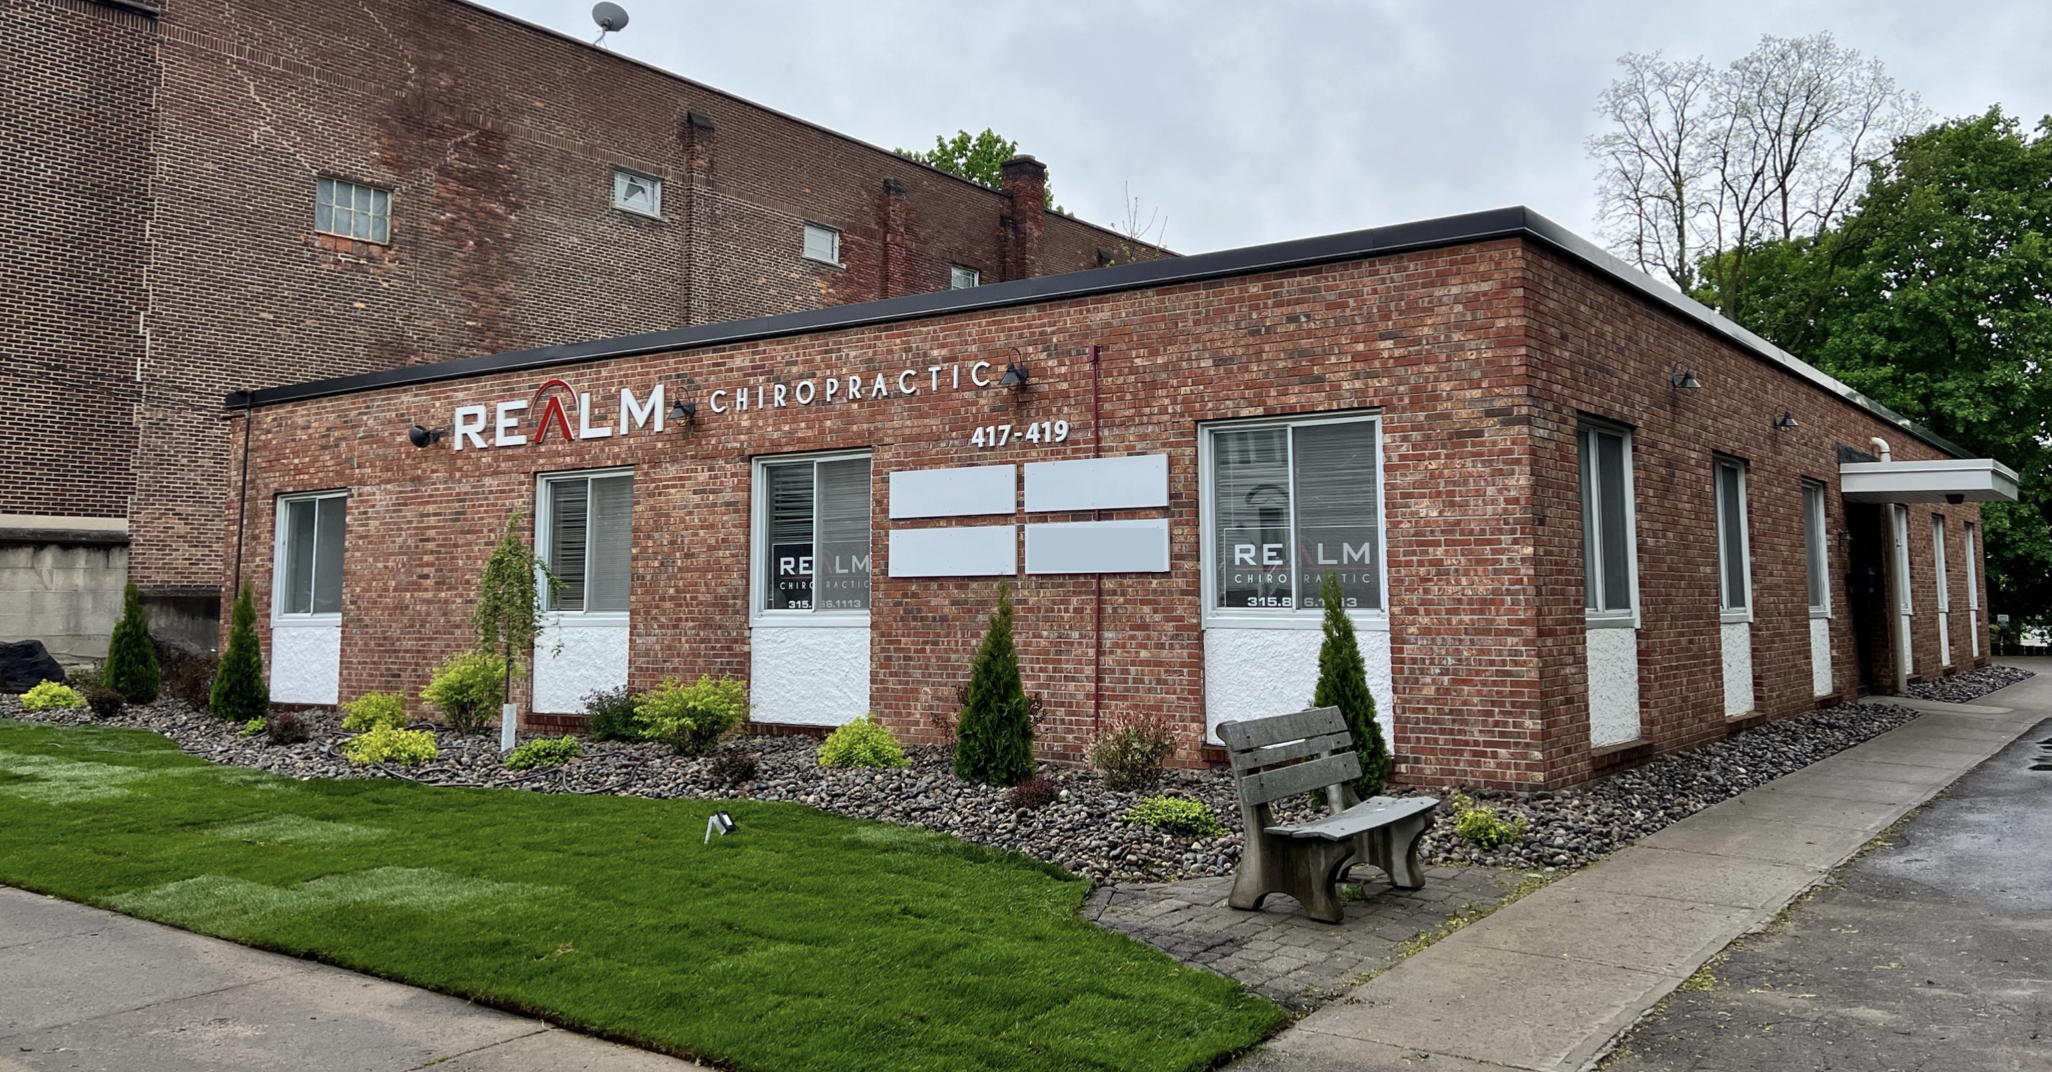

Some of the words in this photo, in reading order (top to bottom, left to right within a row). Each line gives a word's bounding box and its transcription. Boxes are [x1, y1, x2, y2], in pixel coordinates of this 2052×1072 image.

[454, 379, 665, 451] REALM
[710, 361, 991, 413] CHIROPRACTIC
[971, 420, 1069, 448] 417-419
[1234, 573, 1371, 584] CHIRORATIC
[779, 580, 870, 590] CHIRORACTIC
[1247, 597, 1358, 607] 315.86.113
